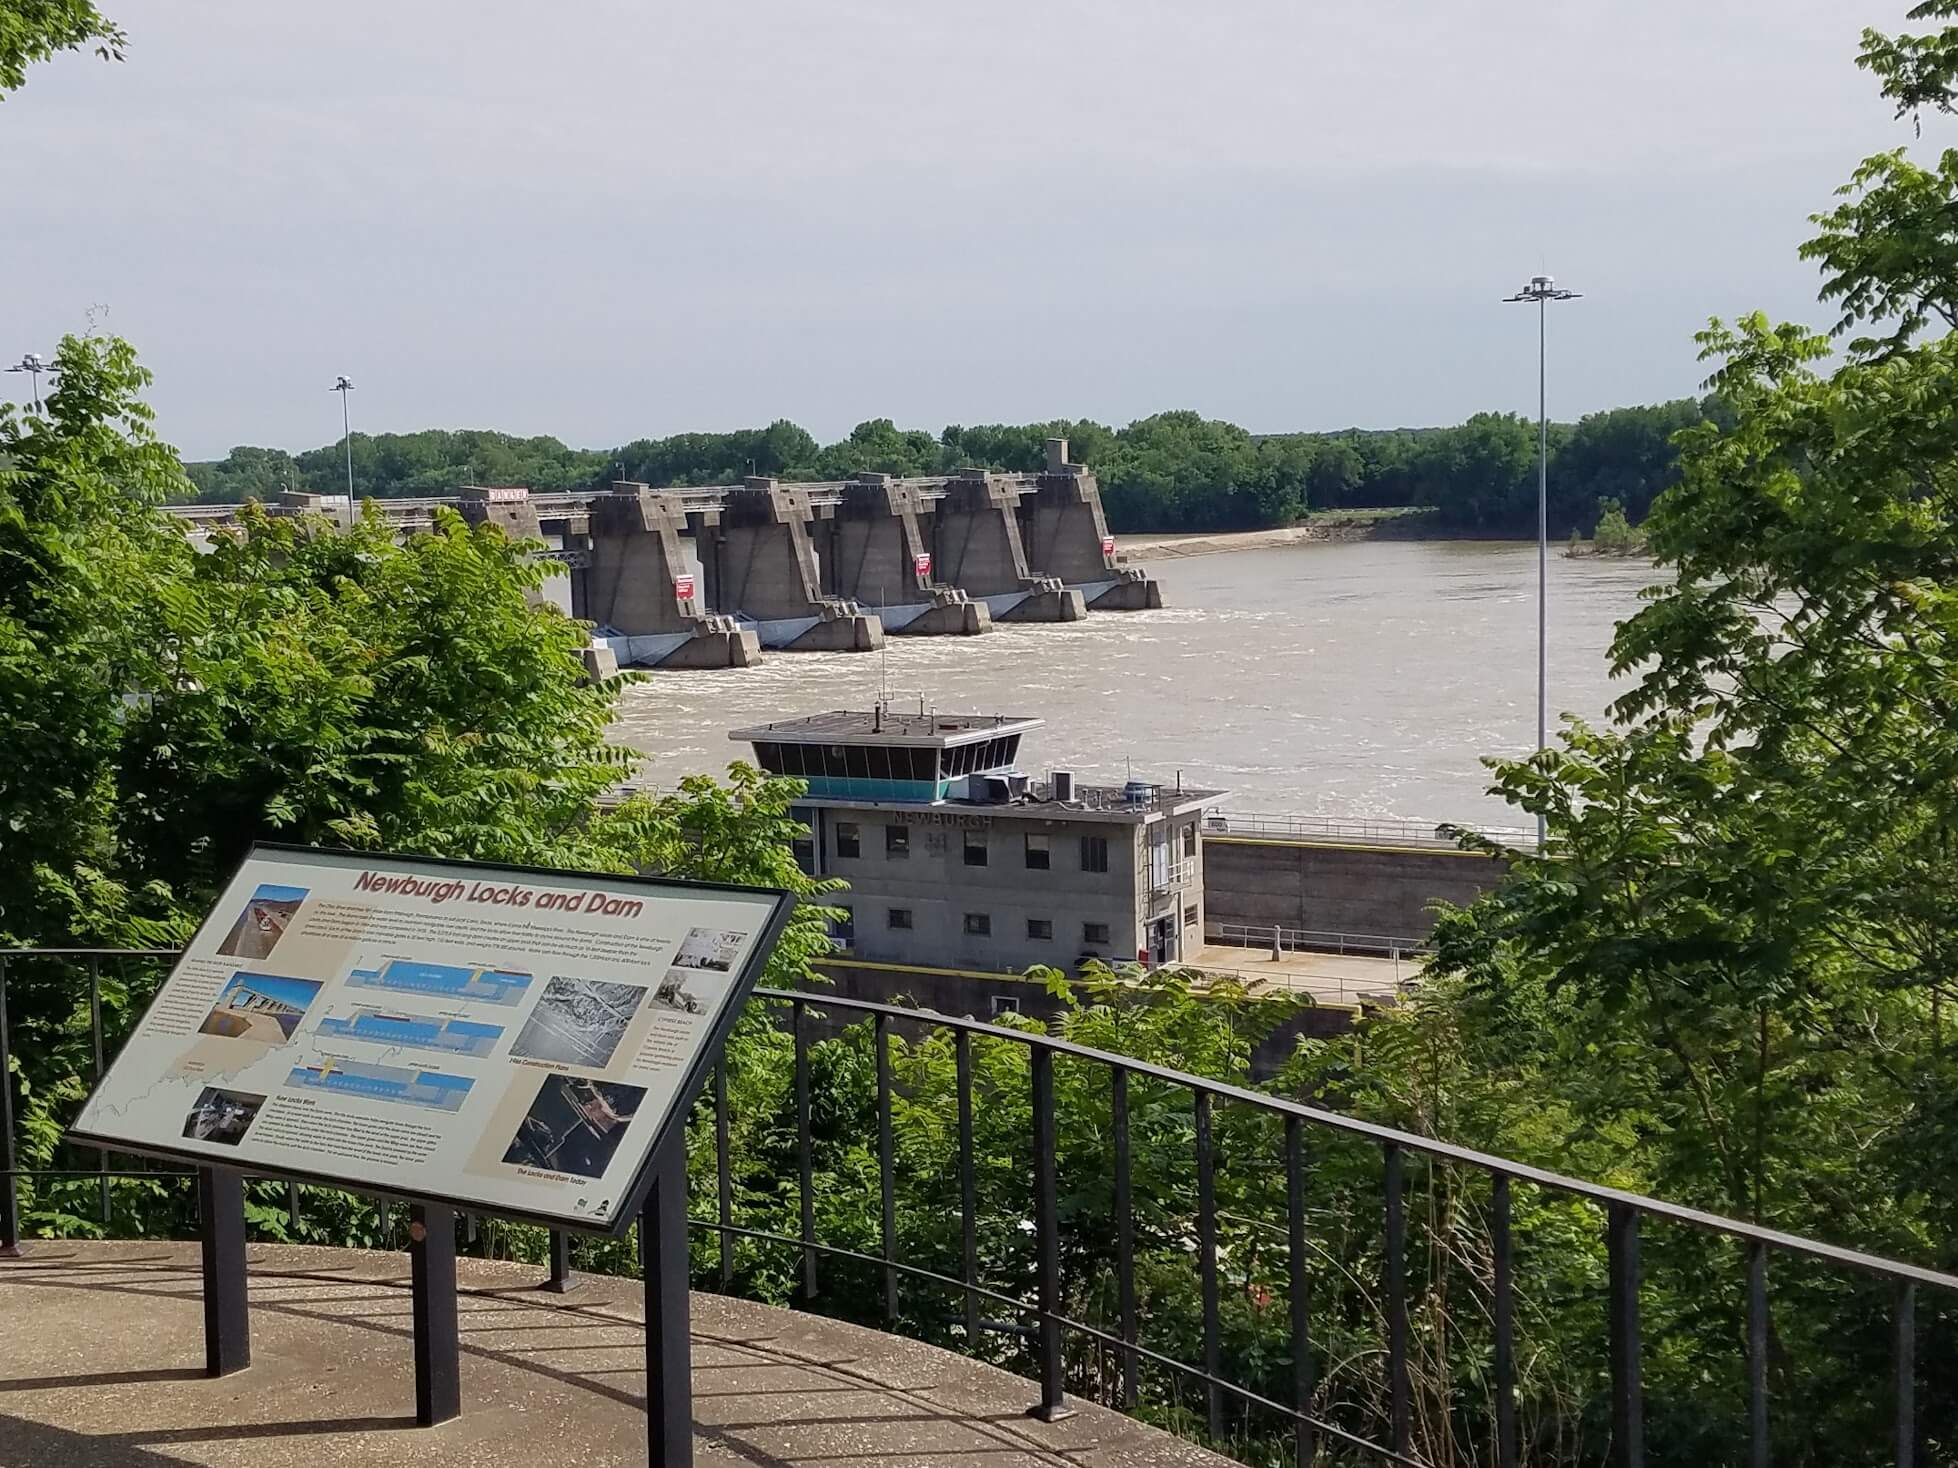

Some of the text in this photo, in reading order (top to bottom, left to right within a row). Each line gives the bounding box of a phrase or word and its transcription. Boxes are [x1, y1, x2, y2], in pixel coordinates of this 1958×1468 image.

[354, 871, 644, 918] Newburgh Locks and Dam
